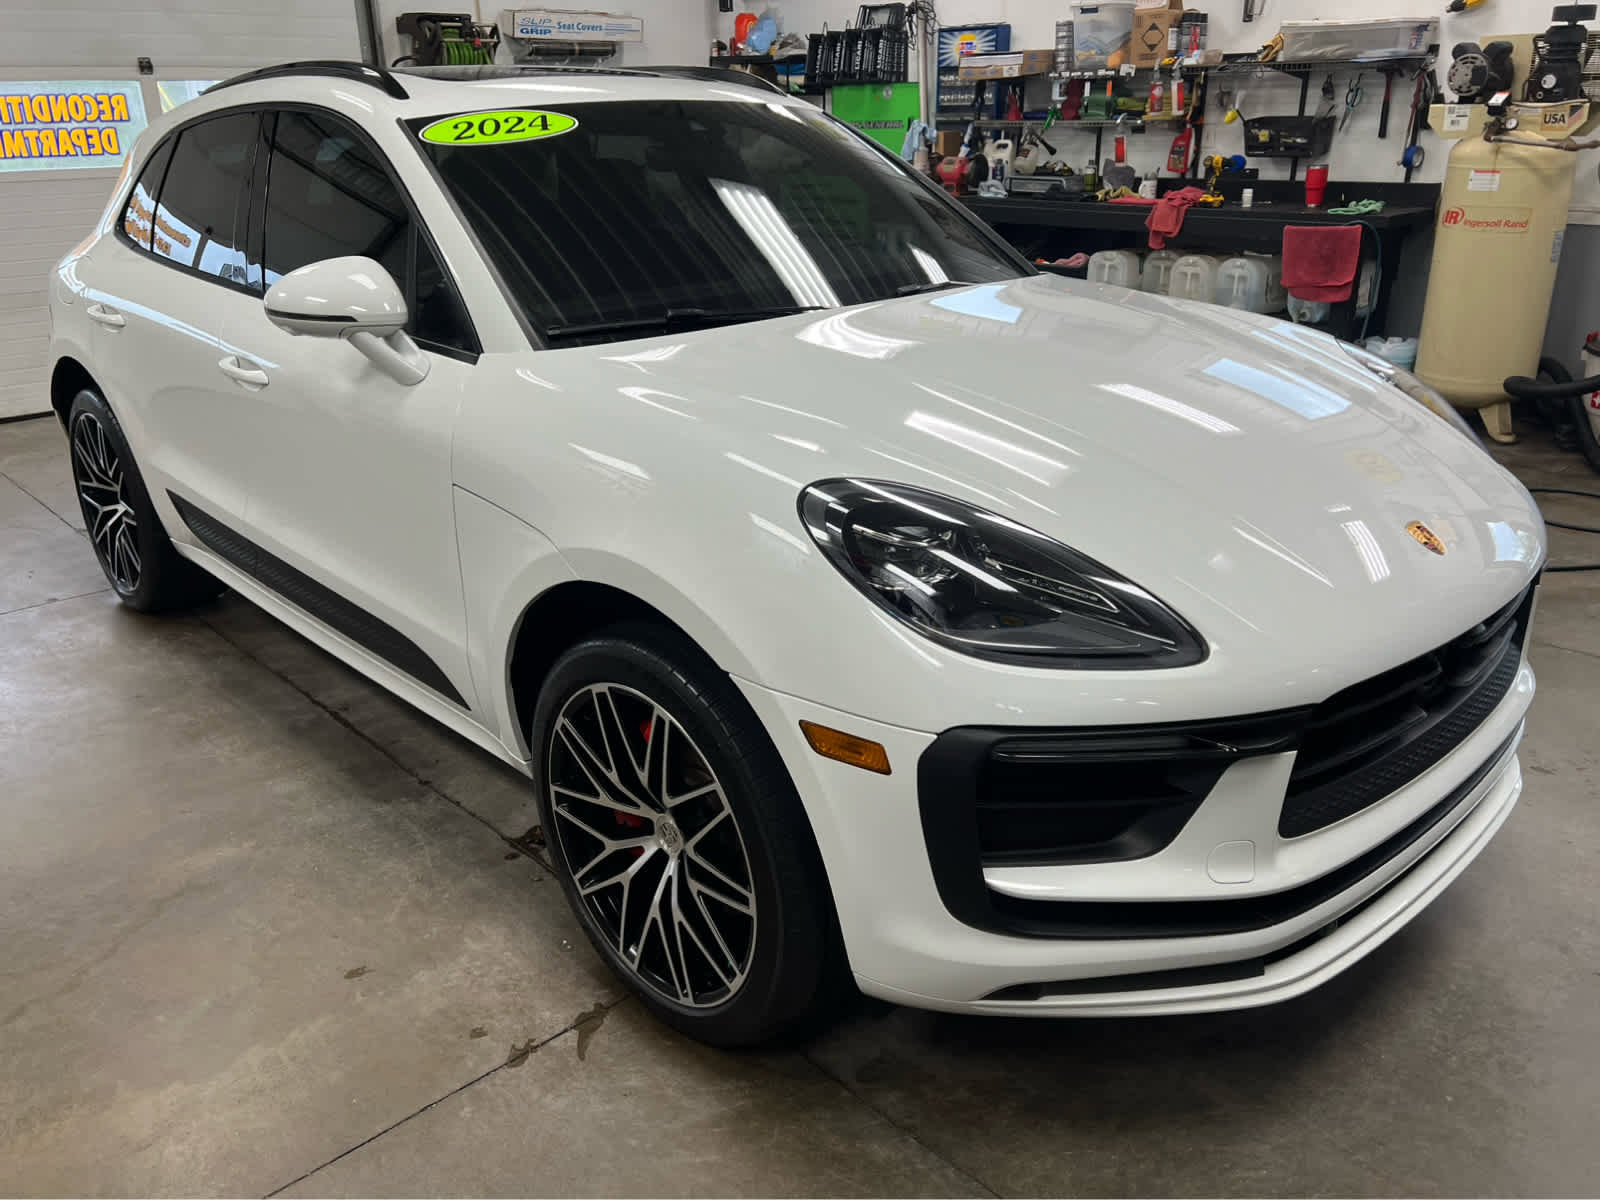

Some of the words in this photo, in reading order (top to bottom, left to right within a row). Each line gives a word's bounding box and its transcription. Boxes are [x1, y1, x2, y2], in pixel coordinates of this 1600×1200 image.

[520, 17, 552, 25] SLIP
[520, 27, 552, 35] GRIP
[557, 22, 575, 31] Seat
[576, 22, 603, 32] Covers
[1543, 113, 1566, 124] USA
[452, 114, 552, 141] 2024
[1503, 218, 1529, 229] Rand
